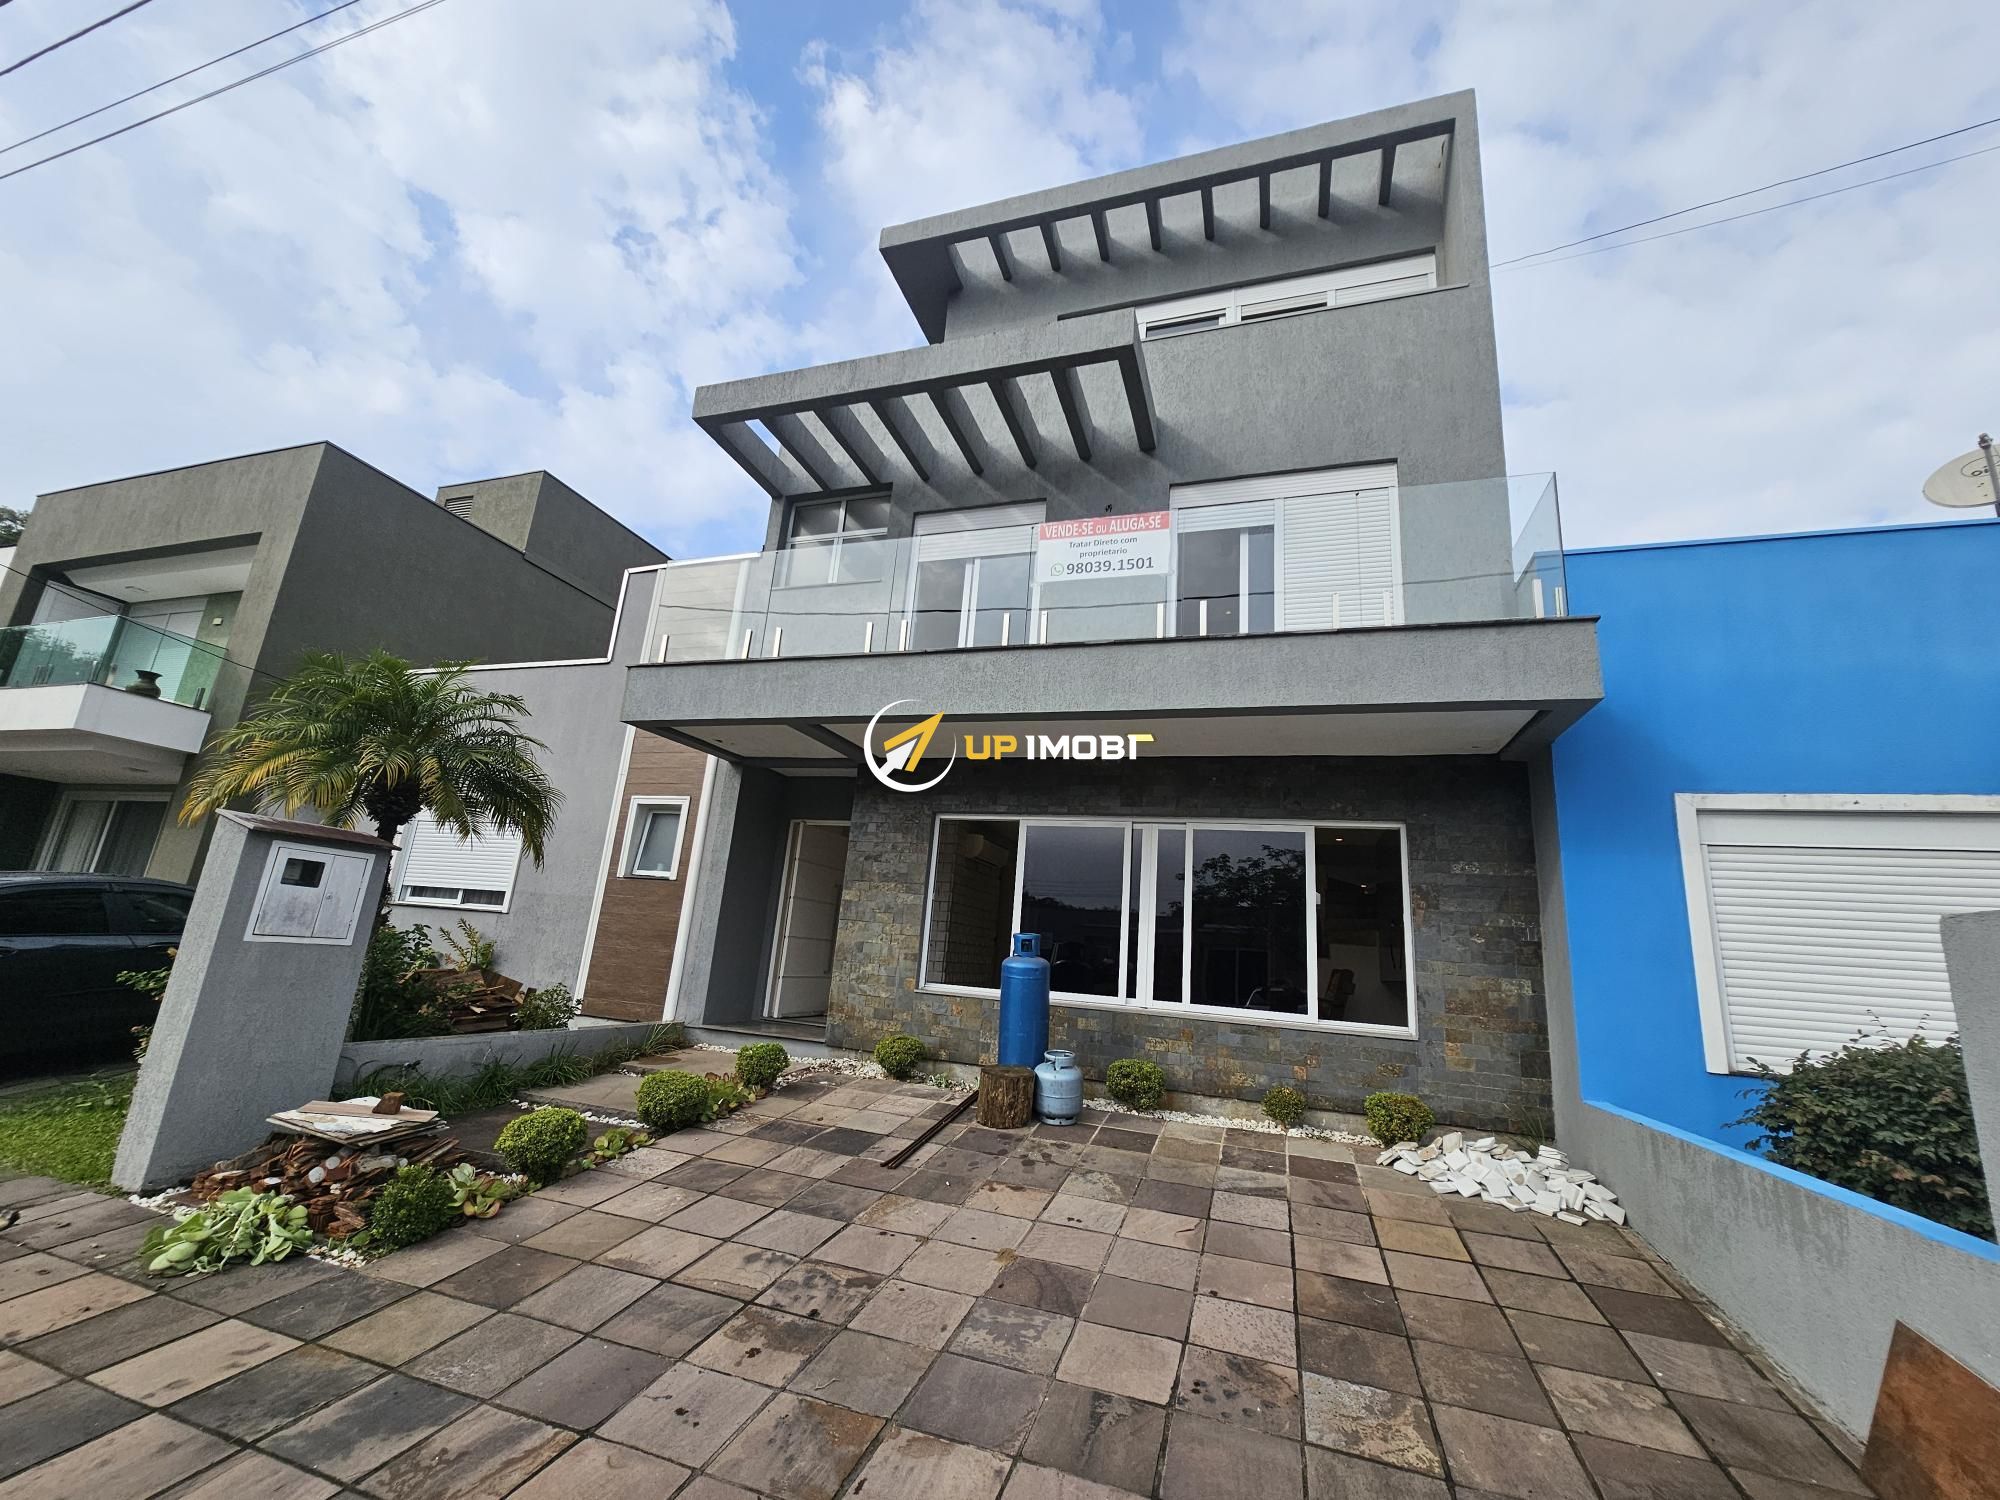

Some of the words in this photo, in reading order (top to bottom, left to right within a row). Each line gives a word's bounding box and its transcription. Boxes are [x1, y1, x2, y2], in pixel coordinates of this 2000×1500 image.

[1045, 521, 1094, 538] VENDE-SE
[1095, 524, 1107, 534] ou
[1108, 515, 1162, 533] ALUGA-SE
[1069, 540, 1092, 549] Tratar
[1093, 538, 1119, 547] Direto
[1079, 547, 1128, 559] proprietario
[1066, 557, 1154, 575] 98039.1501
